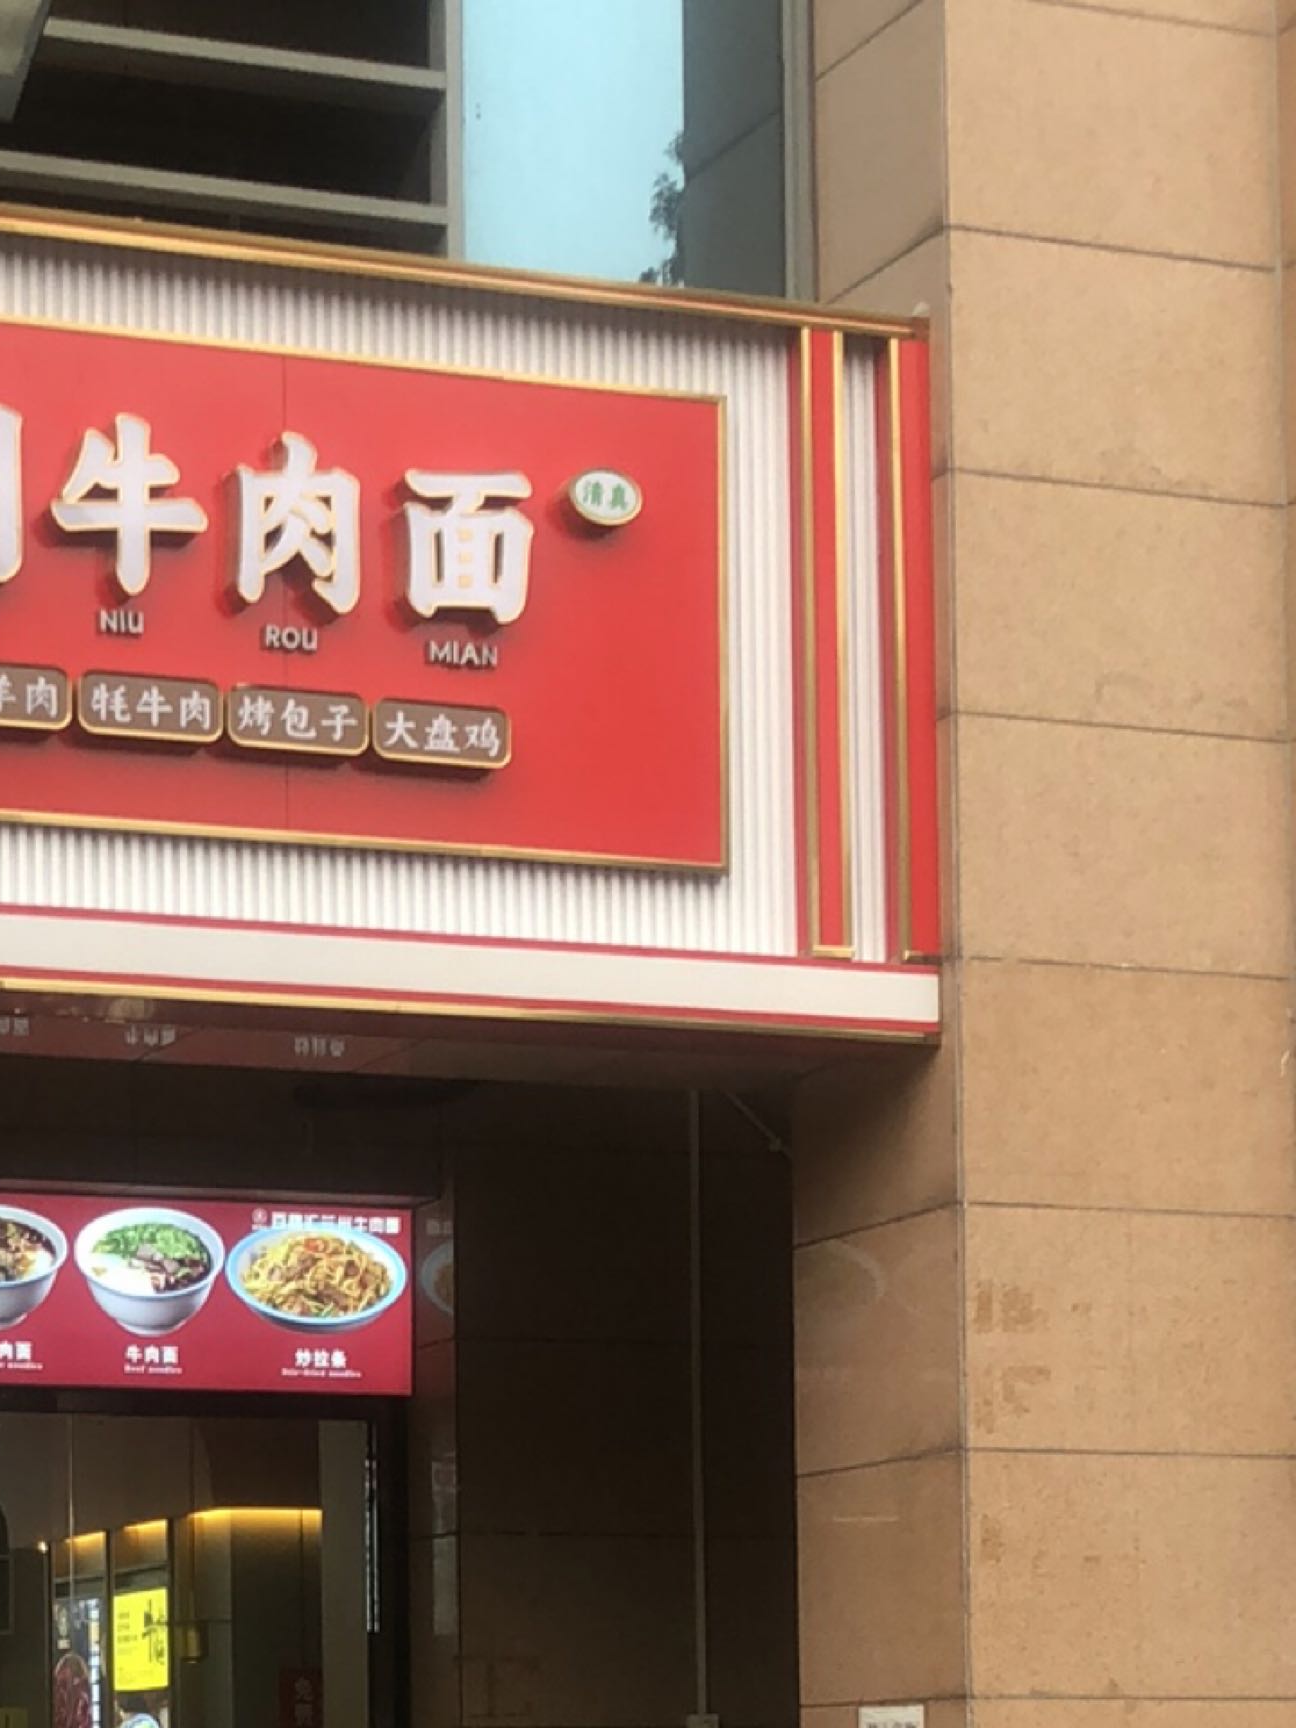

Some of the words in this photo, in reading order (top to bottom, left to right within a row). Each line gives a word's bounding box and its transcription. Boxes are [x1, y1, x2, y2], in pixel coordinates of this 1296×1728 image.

[582, 480, 629, 511] 清真
[98, 608, 145, 634] NIU
[264, 622, 318, 651] ROU
[429, 639, 498, 666] MIAN
[89, 681, 214, 730] 牦牛肉
[237, 694, 359, 744] 烤包子
[381, 713, 502, 757] 大盘鸡
[125, 1345, 180, 1365] 牛肉面
